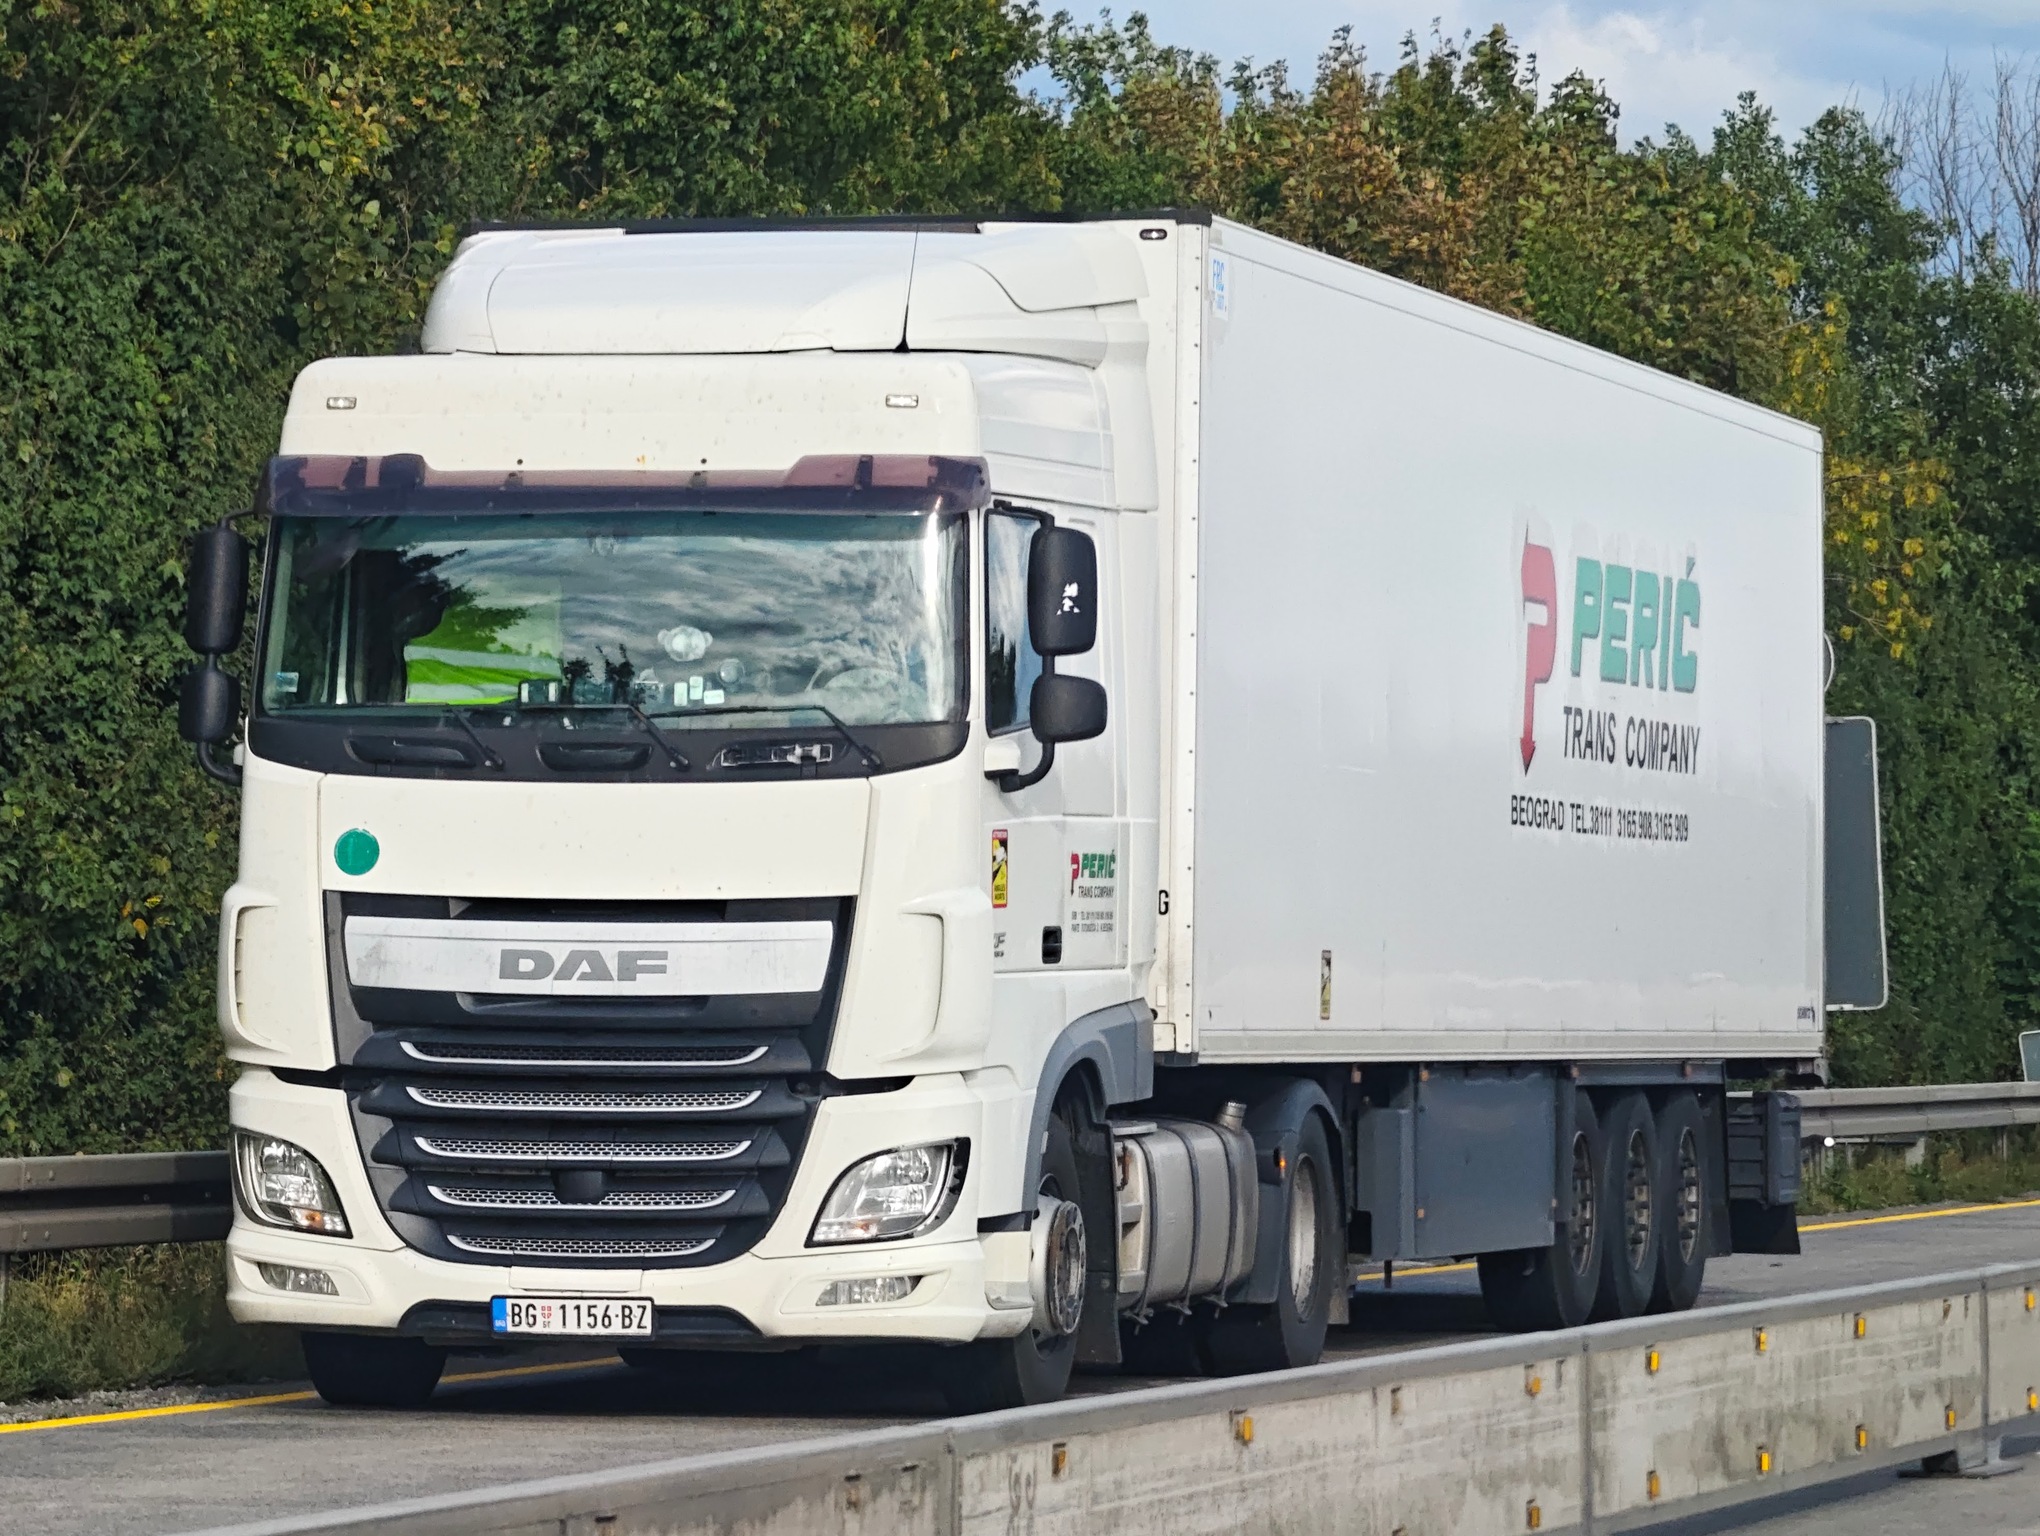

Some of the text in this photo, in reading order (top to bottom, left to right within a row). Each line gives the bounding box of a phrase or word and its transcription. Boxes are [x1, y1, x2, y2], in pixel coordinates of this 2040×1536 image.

[1570, 555, 1701, 694] PERIĆ
[1563, 705, 1701, 776] TRANS COMPANY
[1511, 794, 1565, 831] BEOGRAD
[1569, 802, 1613, 837] TEL.38111
[1617, 808, 1636, 839] 3165
[1674, 813, 1689, 842] 909
[1080, 849, 1116, 879] PERIĆ
[1078, 885, 1115, 899] TRANS COMPANY
[498, 948, 669, 982] DAF
[511, 1302, 538, 1328] BG
